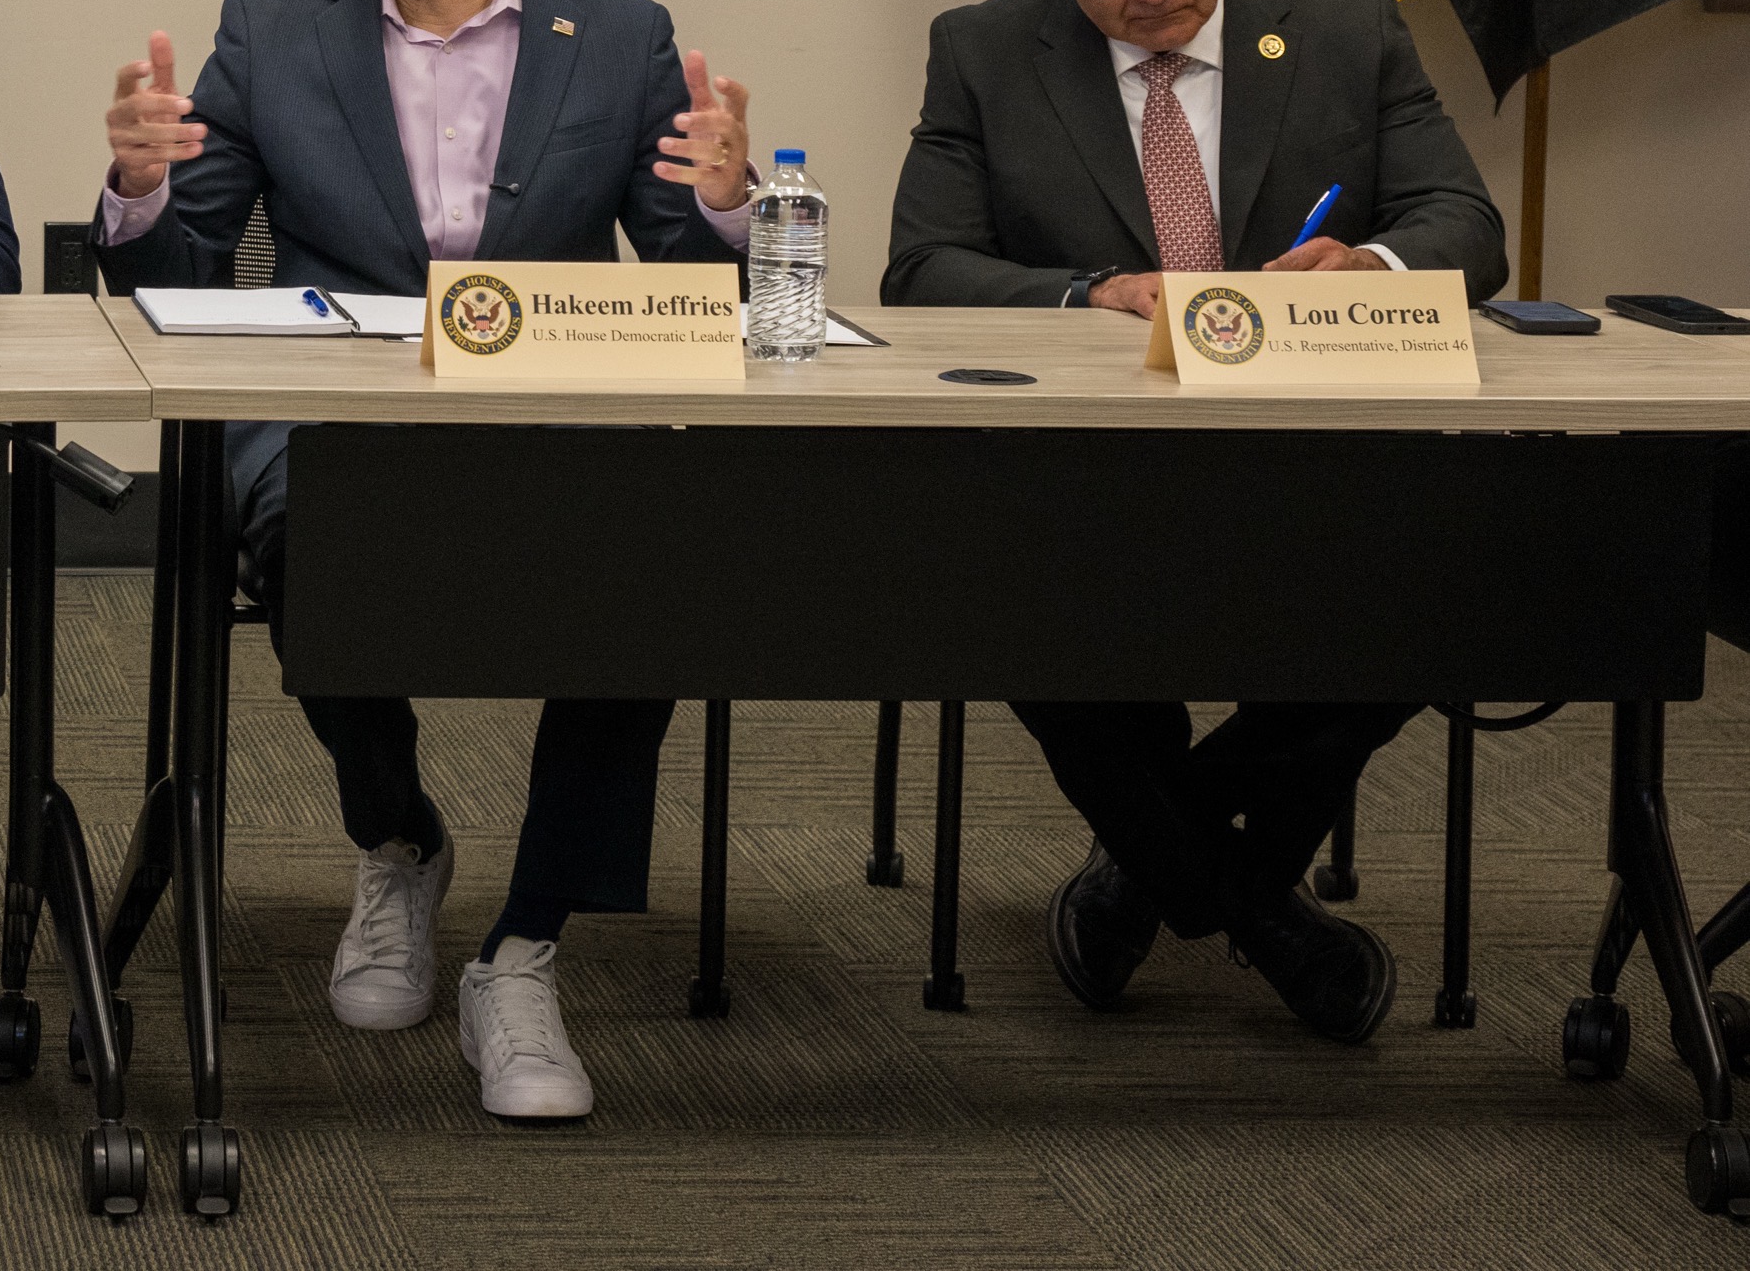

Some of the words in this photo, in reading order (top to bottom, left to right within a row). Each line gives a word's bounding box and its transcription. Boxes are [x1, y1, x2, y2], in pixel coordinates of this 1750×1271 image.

[447, 283, 466, 301] U.S.
[465, 276, 506, 292] HOUSE
[503, 289, 518, 304] OF
[1205, 289, 1245, 304] HOUSE
[1243, 301, 1258, 315] OF
[531, 293, 633, 316] Hakeem
[641, 295, 733, 317] Jeffries
[1286, 303, 1339, 326] Lou
[1347, 302, 1440, 325] Correa
[444, 317, 521, 353] REPRESENTATIVES
[532, 329, 561, 342] U.S.
[566, 329, 607, 342] House
[611, 329, 686, 343] Democratic
[690, 330, 736, 344] Leader
[1268, 339, 1297, 352] U.S.
[1300, 339, 1399, 355] Representative,
[1402, 339, 1449, 352] District
[1452, 339, 1469, 351] 46
